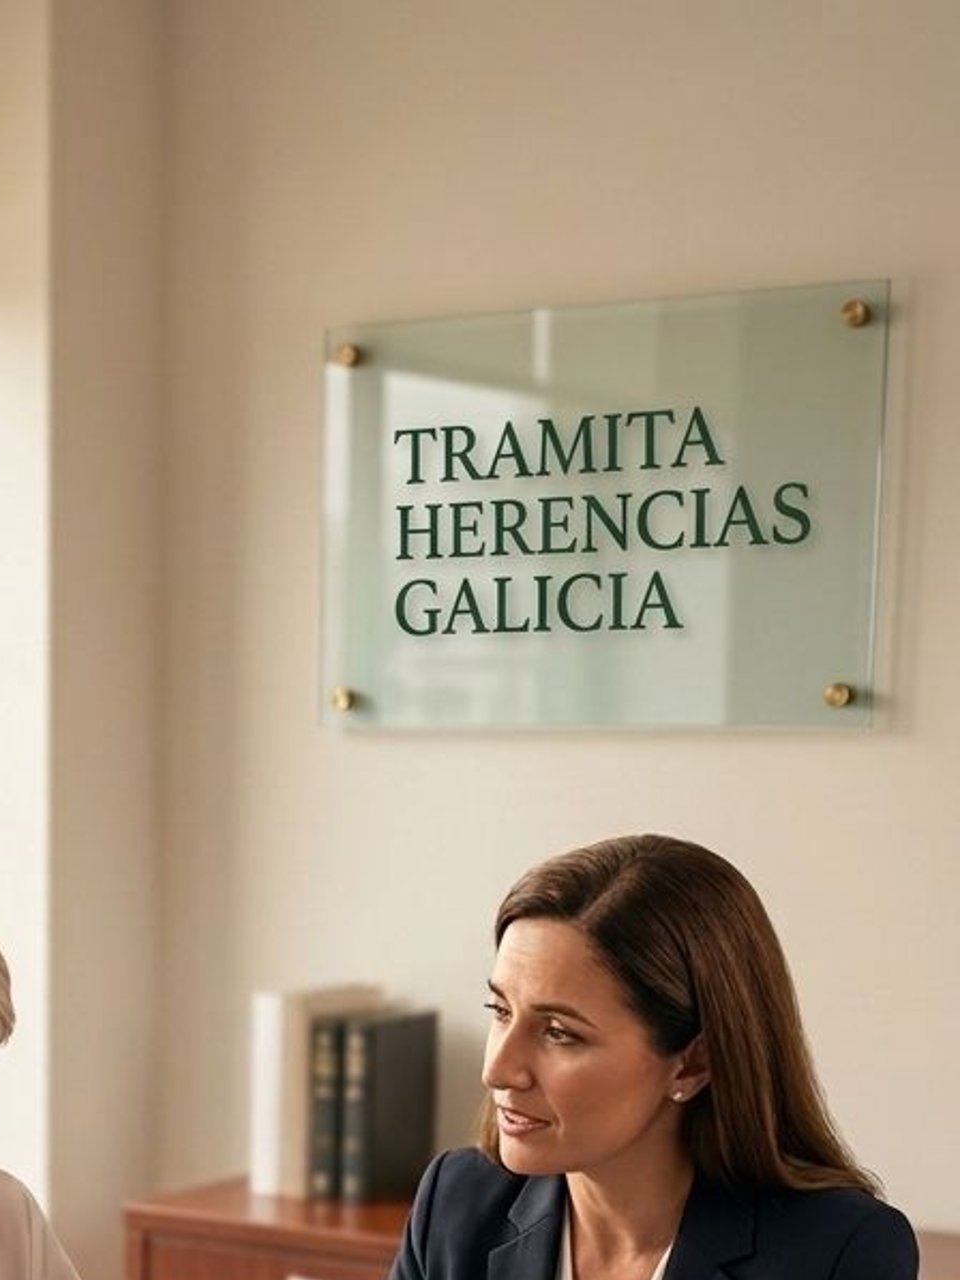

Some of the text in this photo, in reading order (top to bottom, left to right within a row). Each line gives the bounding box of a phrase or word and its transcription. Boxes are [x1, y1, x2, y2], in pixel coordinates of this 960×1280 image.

[394, 406, 726, 485] TRAMITA
[396, 482, 811, 560] HERENCIAS
[395, 570, 684, 636] GALICIA
